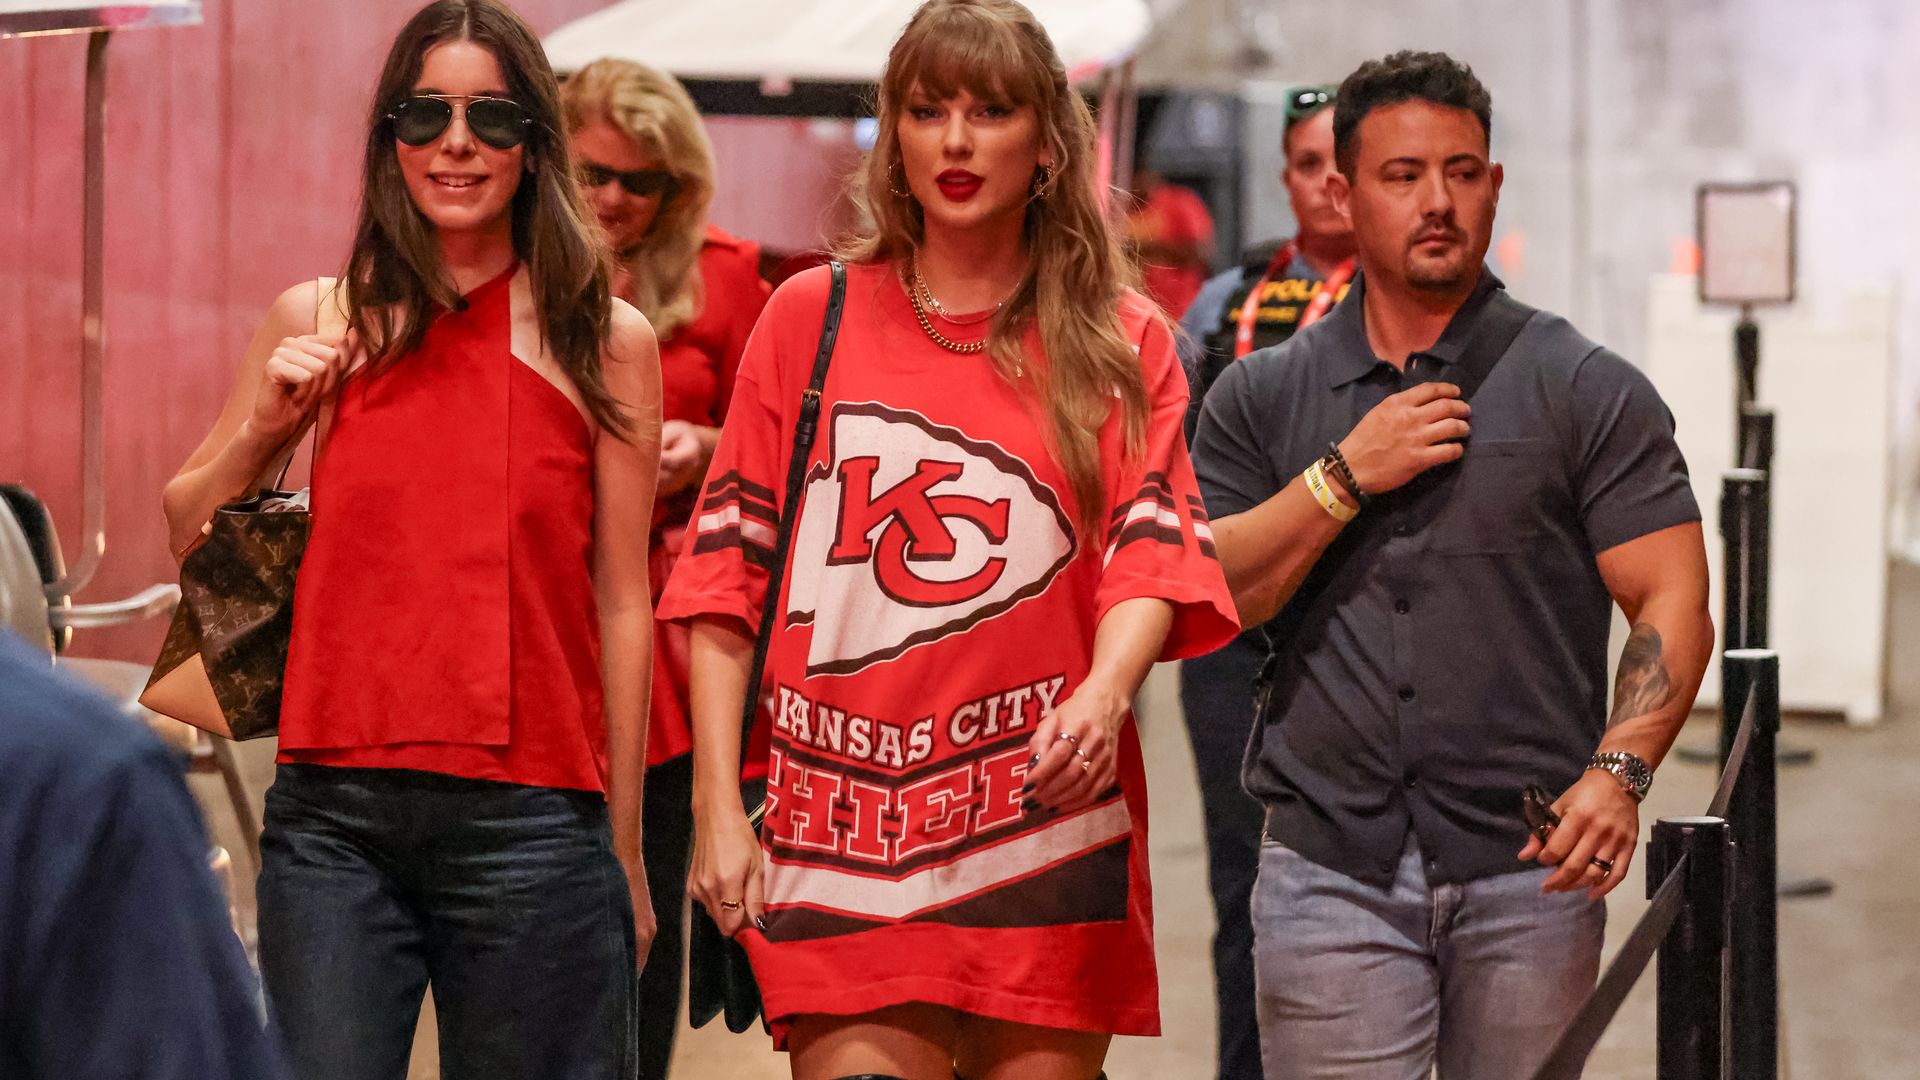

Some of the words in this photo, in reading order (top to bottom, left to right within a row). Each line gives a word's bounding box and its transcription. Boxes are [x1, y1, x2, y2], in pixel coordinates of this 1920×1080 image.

[1260, 279, 1351, 302] POLI
[825, 455, 1011, 608] KC
[776, 683, 936, 770] KANSAS
[947, 672, 1067, 747] CITY
[766, 746, 1029, 863] HIEF
